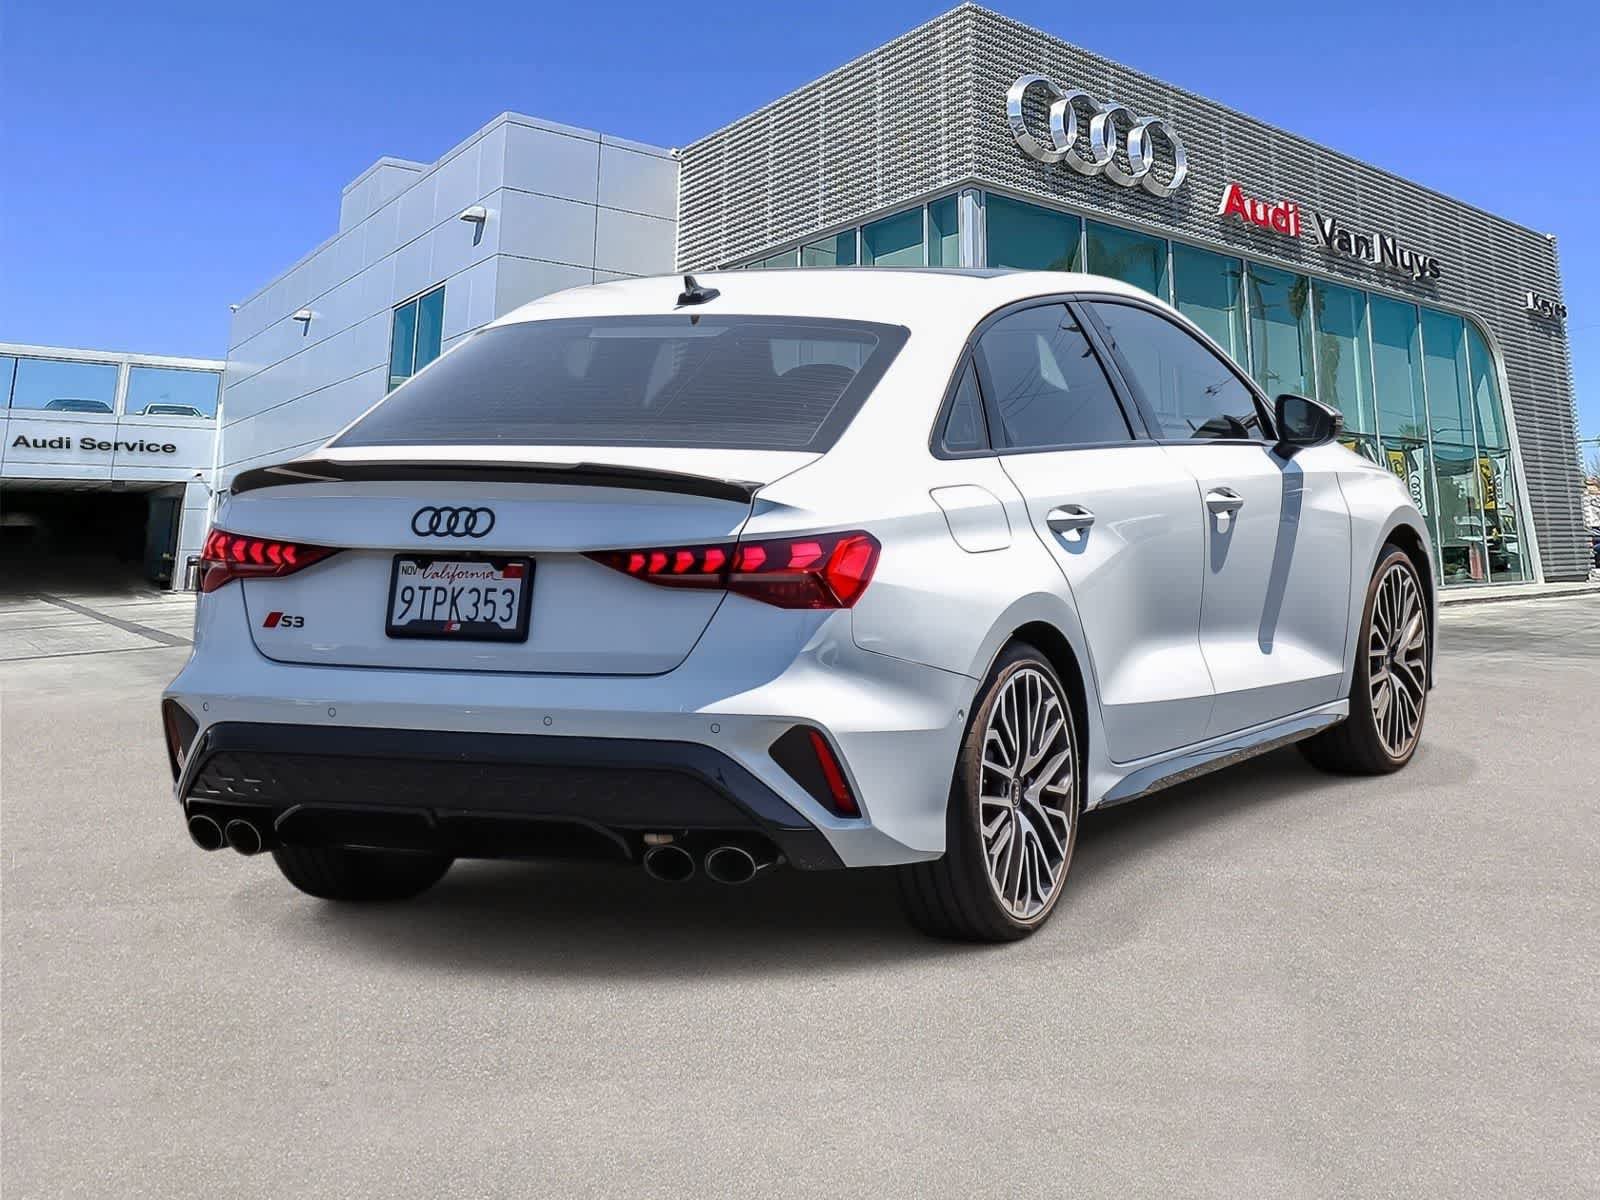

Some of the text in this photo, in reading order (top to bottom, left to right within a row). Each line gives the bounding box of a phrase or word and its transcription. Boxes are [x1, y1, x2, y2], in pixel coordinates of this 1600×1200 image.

[1218, 182, 1441, 281] Audi Van Nuys
[12, 434, 177, 454] Audi Service
[401, 562, 502, 584] NOV California
[397, 585, 515, 622] 9TPK353
[280, 615, 305, 628] S3
